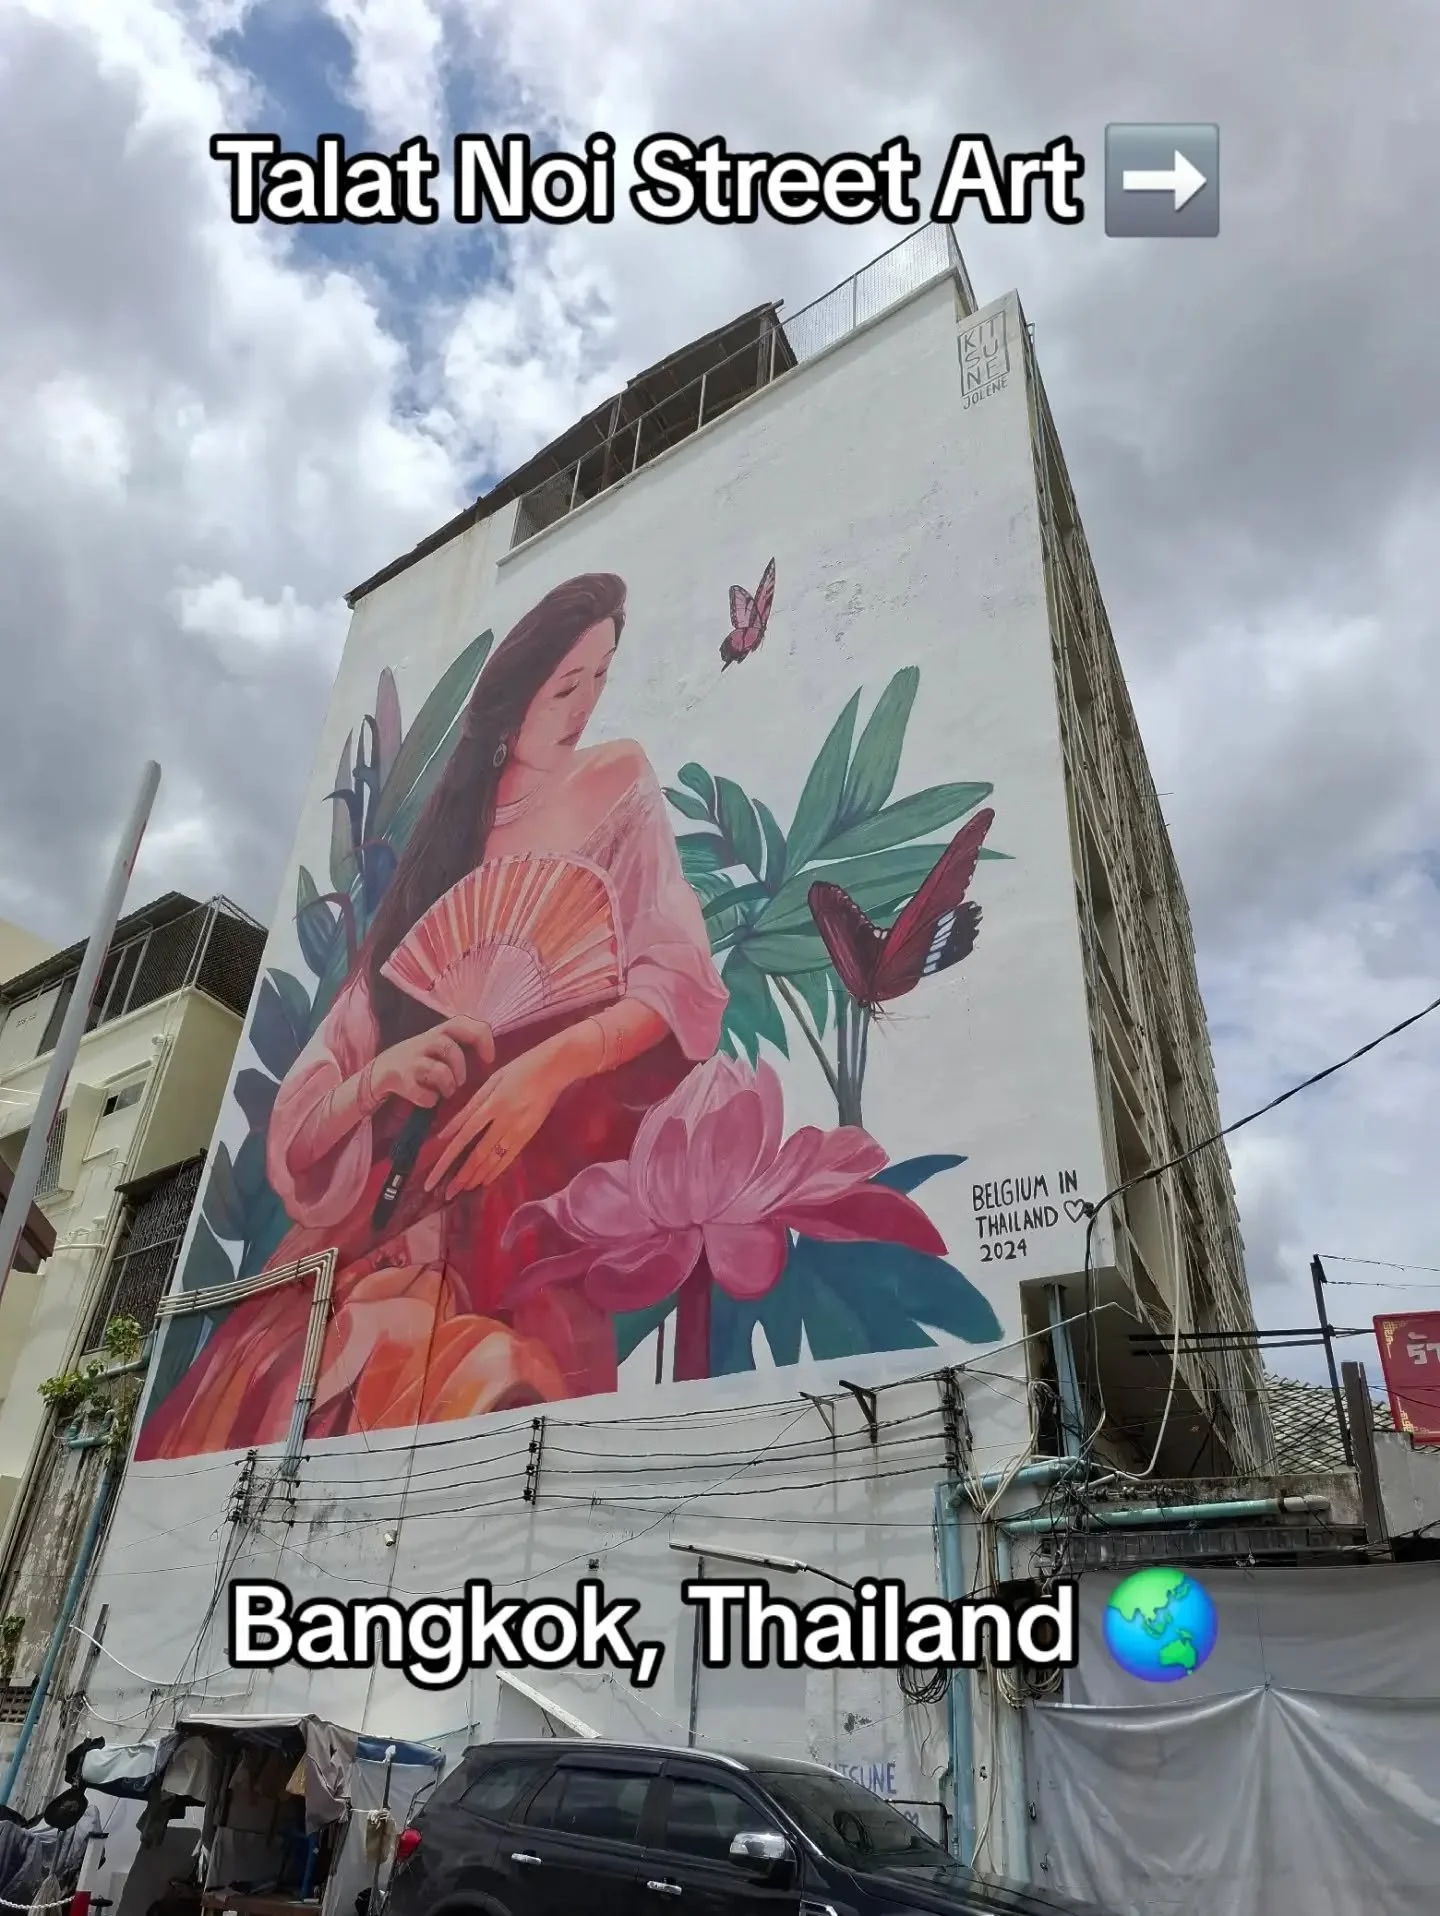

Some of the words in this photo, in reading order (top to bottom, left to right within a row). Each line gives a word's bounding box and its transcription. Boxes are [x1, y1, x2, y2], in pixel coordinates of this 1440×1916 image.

[963, 379, 1008, 410] JOLENE
[972, 1174, 1049, 1212] BELGIUM
[1058, 1169, 1078, 1195] IN
[975, 1205, 1059, 1239] THAILAND
[979, 1238, 1028, 1263] 2024
